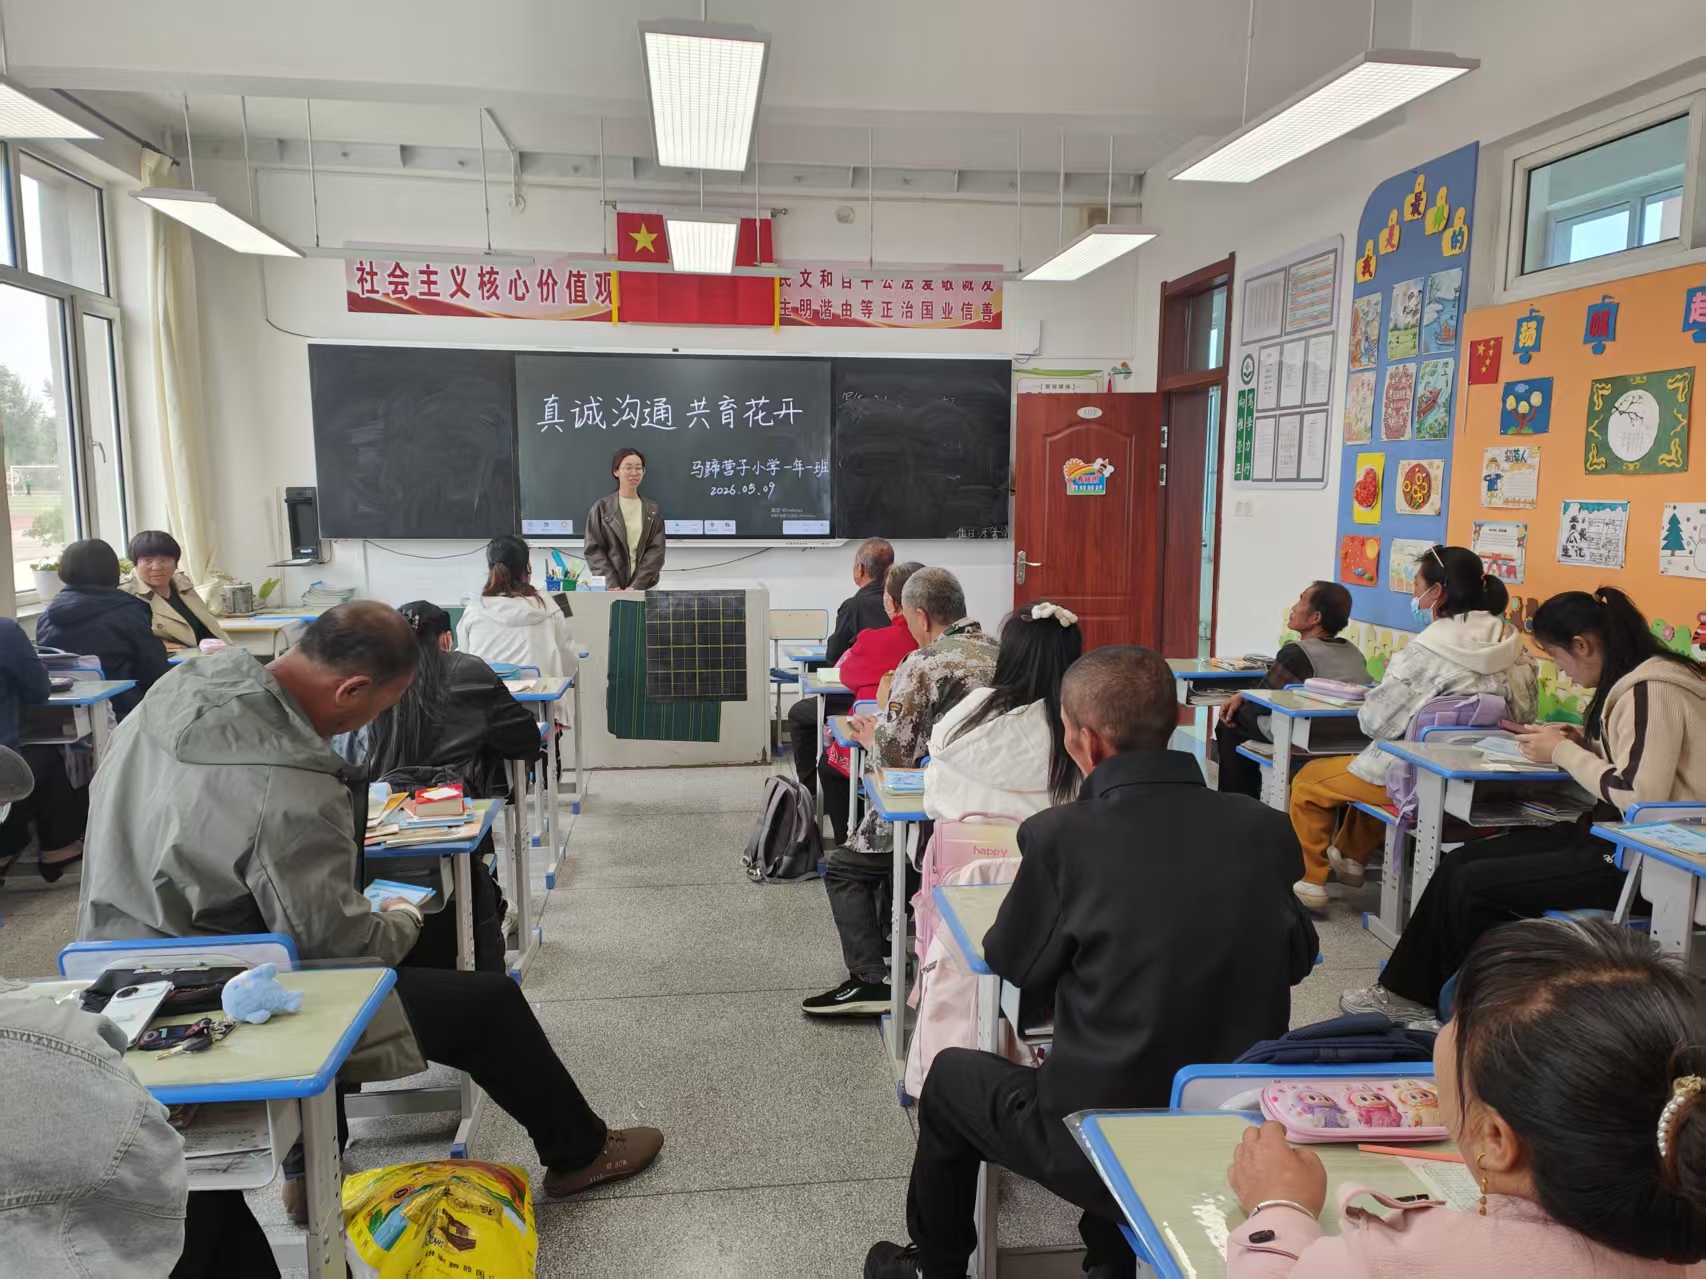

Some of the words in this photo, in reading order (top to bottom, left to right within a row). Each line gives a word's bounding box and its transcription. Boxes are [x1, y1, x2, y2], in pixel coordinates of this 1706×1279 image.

[355, 260, 613, 305] 社会主义核心价值观
[536, 393, 678, 433] 真诚沟通
[686, 395, 803, 430] 共育花开
[972, 845, 1008, 857] happy
